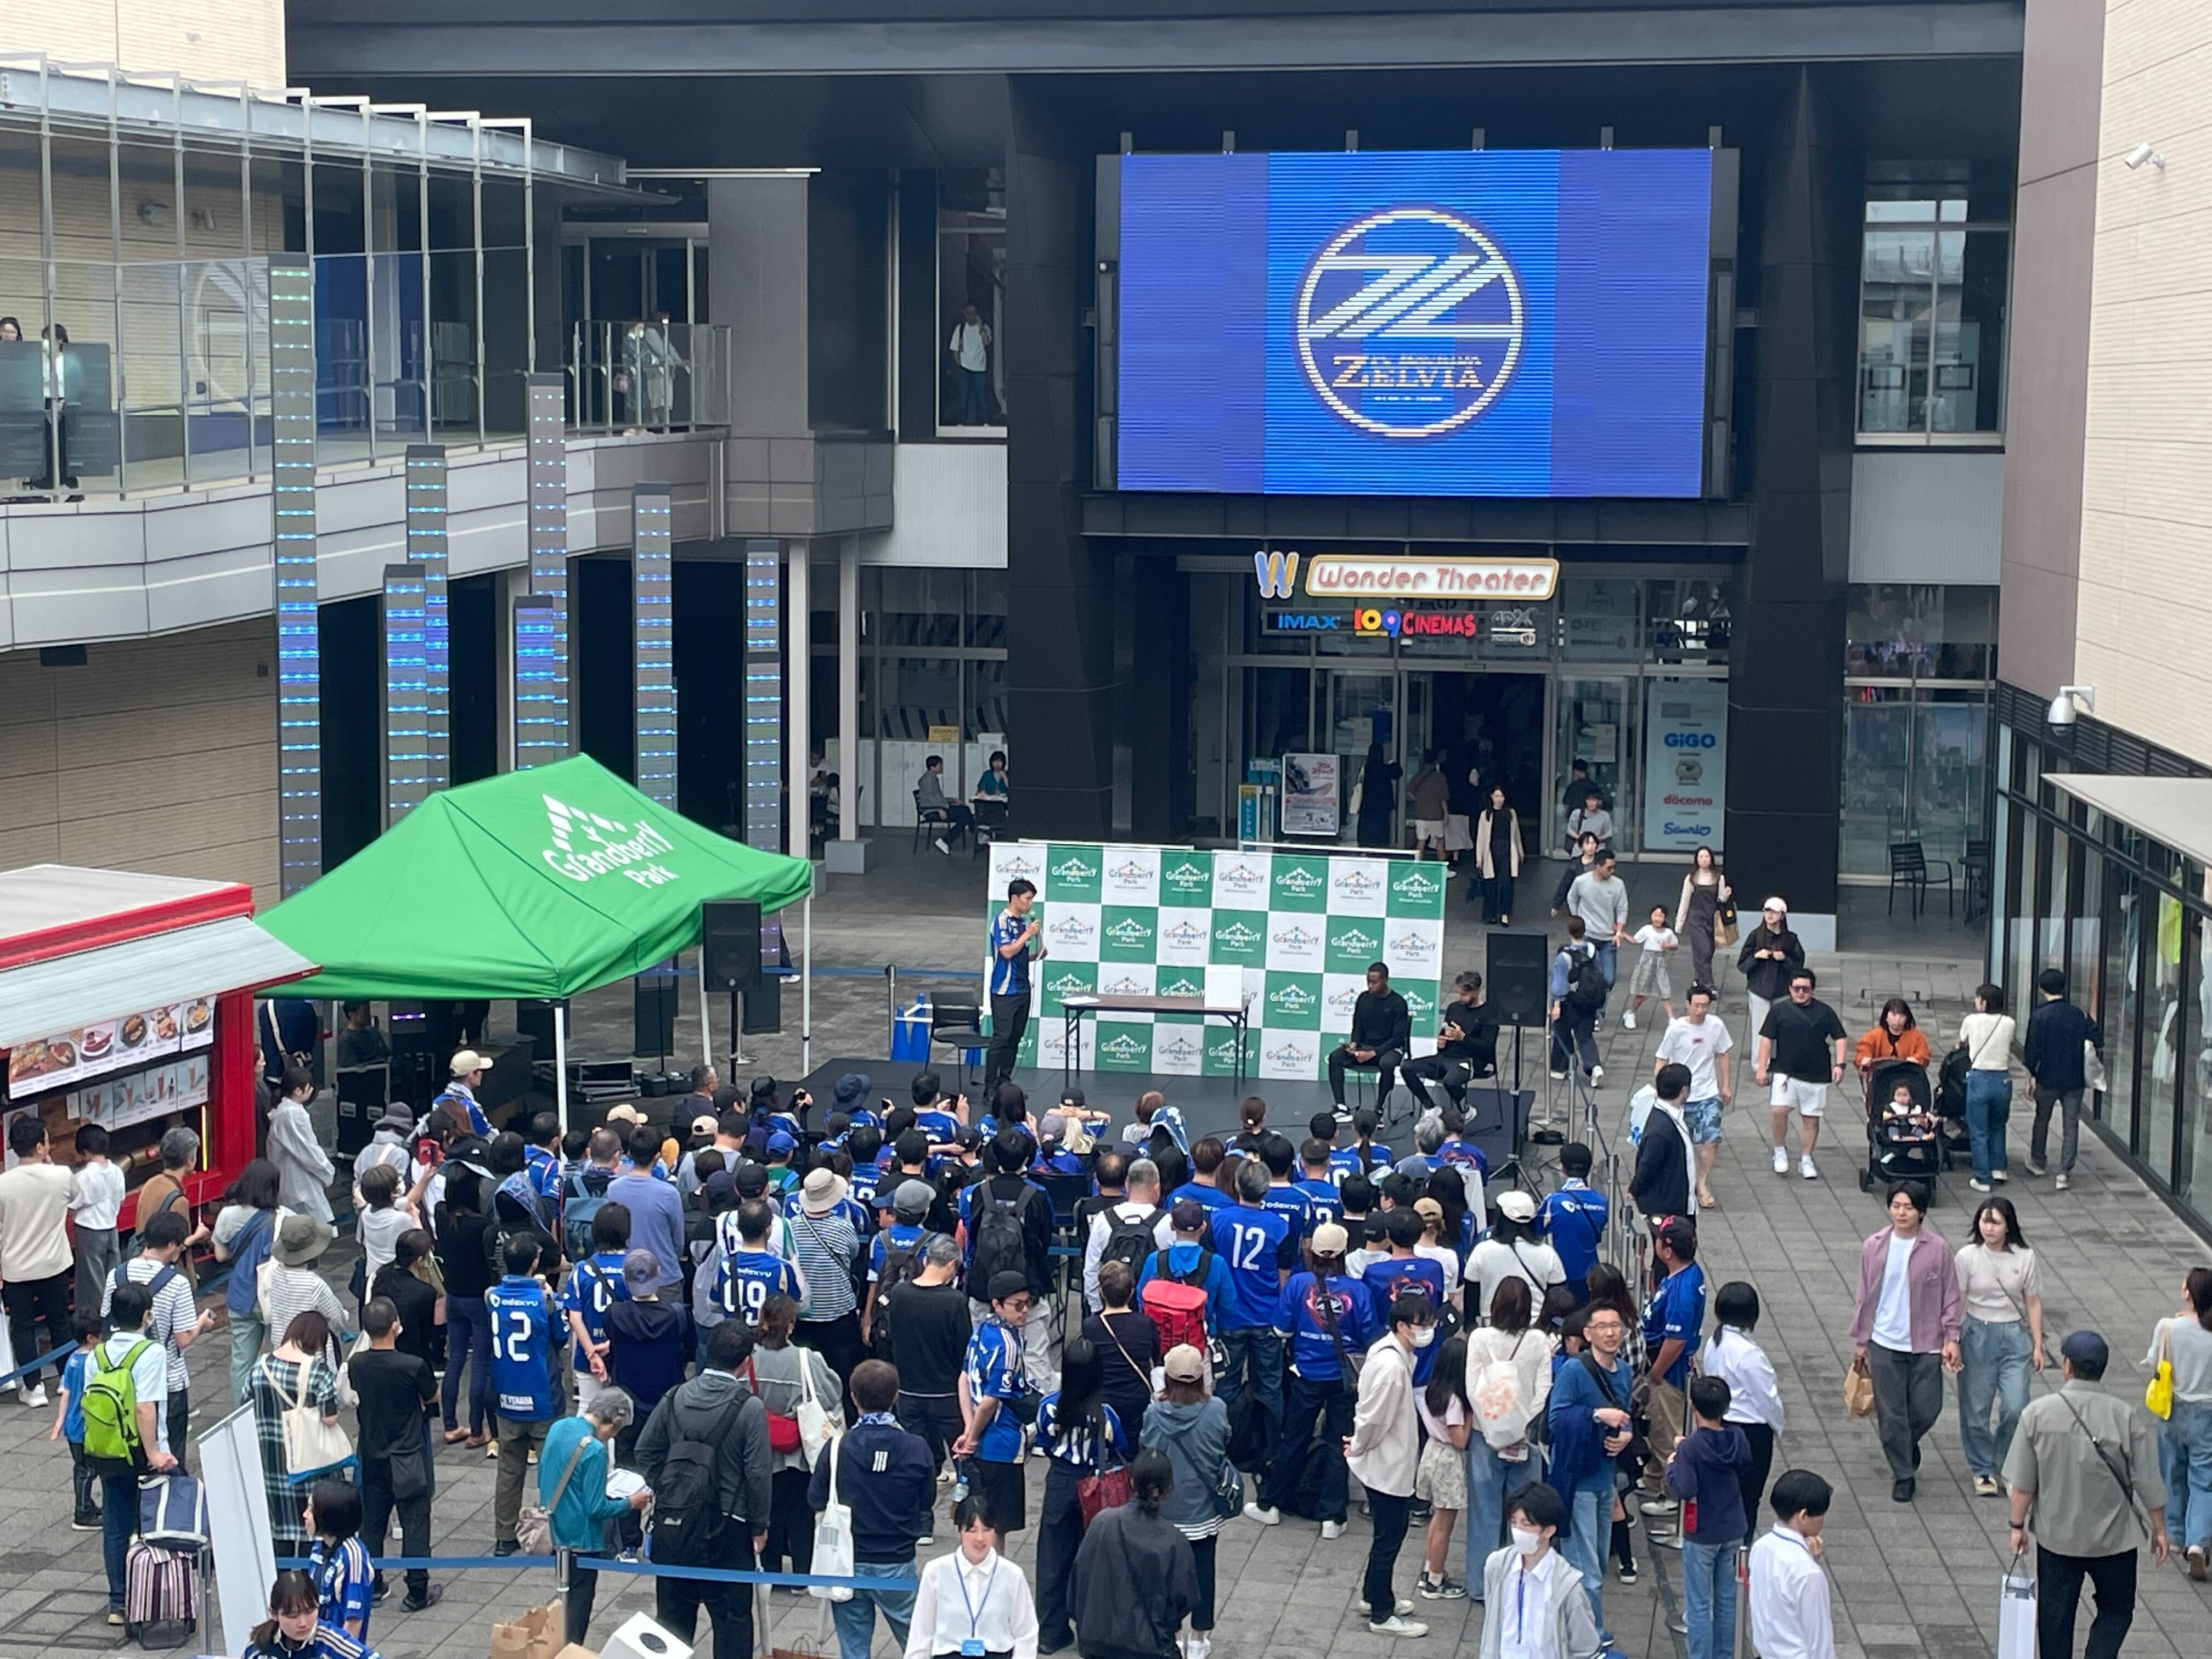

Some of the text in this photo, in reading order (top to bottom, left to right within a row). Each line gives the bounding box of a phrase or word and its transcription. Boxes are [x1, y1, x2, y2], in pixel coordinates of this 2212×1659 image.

[1318, 565, 1545, 591] Wonder Theater
[1278, 614, 1338, 630] IMAX
[1353, 608, 1402, 638] 109
[1663, 794, 1713, 805] docomo
[1663, 822, 1711, 837] Sanrio
[542, 820, 674, 882] Grandberry
[623, 862, 680, 889] Park
[1232, 1223, 1266, 1271] 12
[492, 1311, 531, 1361] 12
